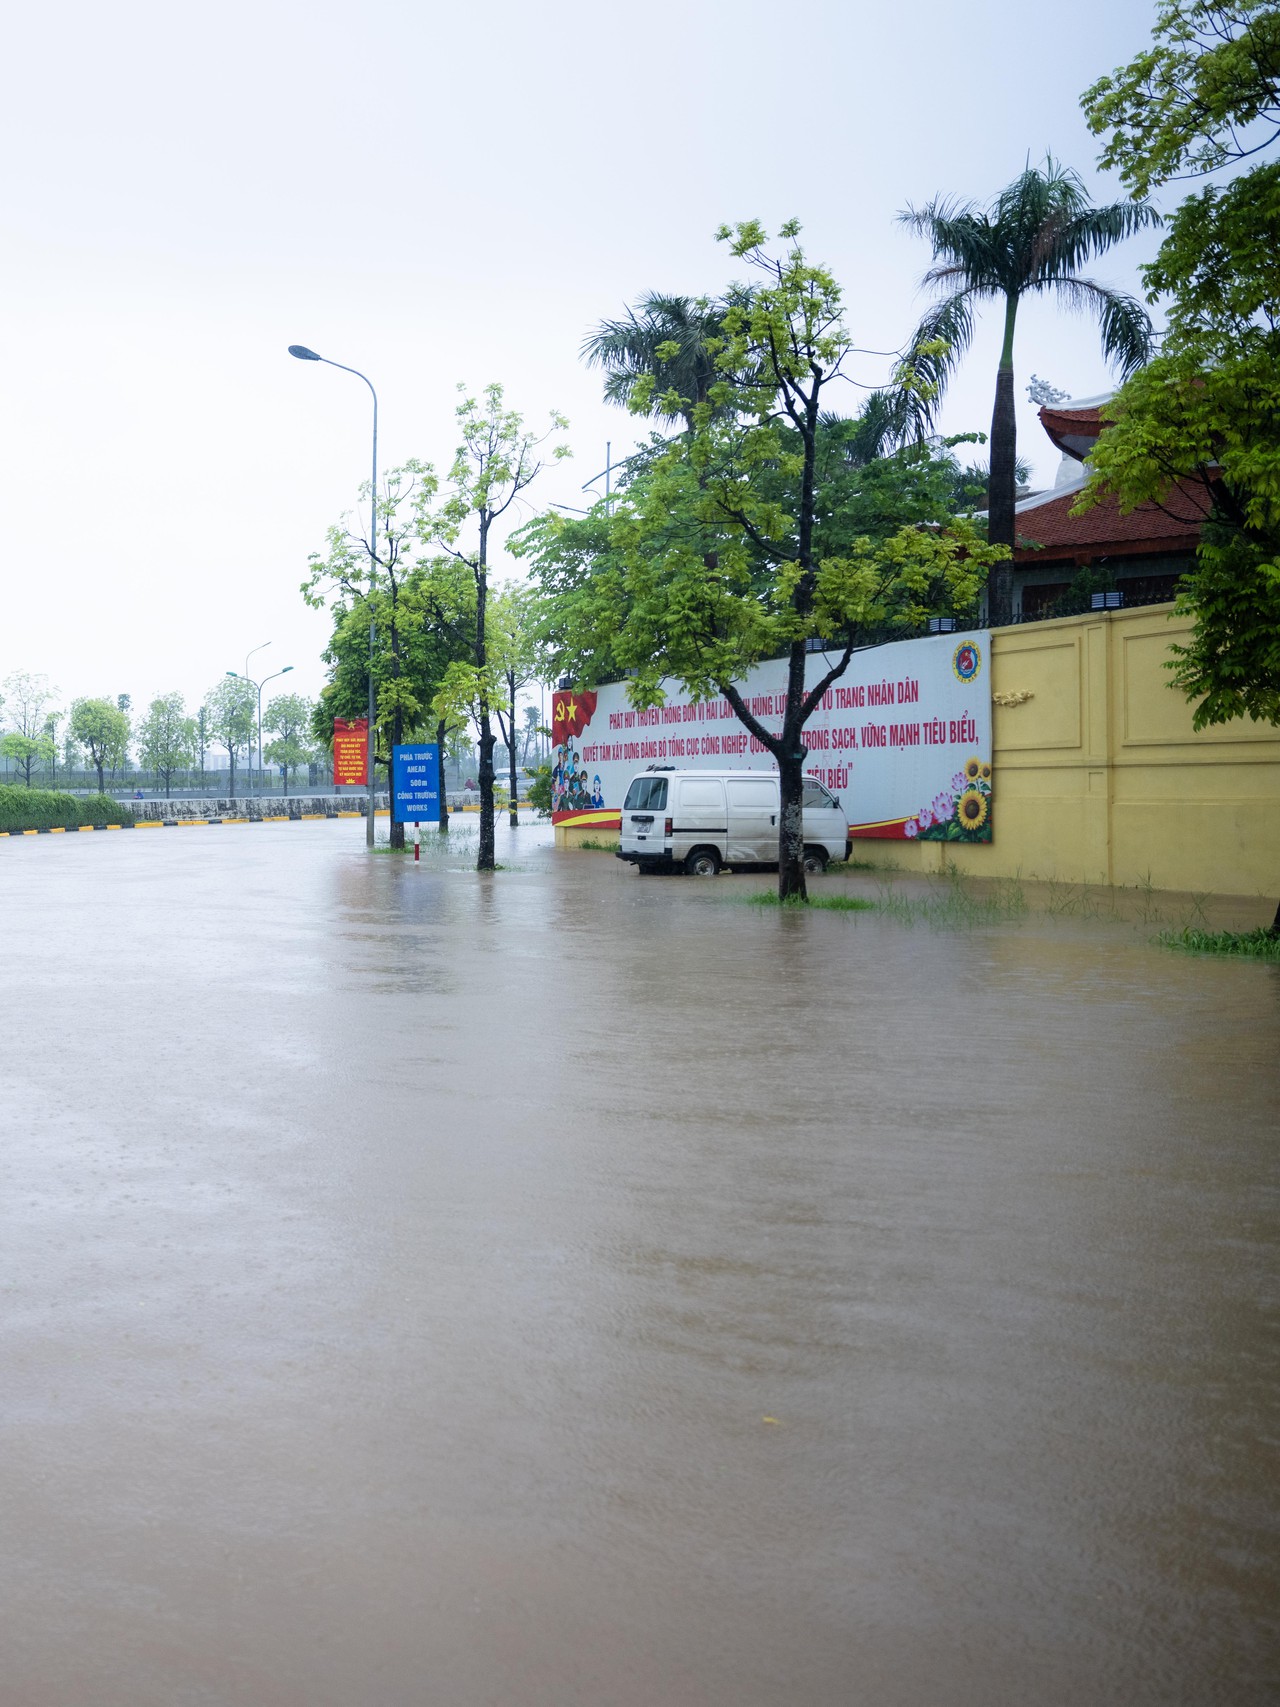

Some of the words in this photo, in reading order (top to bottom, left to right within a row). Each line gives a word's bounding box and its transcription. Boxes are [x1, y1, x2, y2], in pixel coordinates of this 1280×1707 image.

[610, 710, 623, 729] PHÁT
[625, 711, 636, 728] HUY
[706, 701, 718, 720] HAI
[752, 693, 773, 716] HÙNG
[775, 693, 788, 718] LỰ
[835, 685, 865, 709] TRANG
[868, 679, 895, 707] NHÂN
[897, 676, 918, 704] DÂN
[583, 741, 598, 764] QUYẾT
[600, 742, 610, 761] TÂM
[612, 741, 623, 760] XÂY
[624, 742, 639, 763] DỰNG
[641, 736, 657, 758] ĐẢNG
[658, 737, 667, 761] BỘ
[668, 732, 684, 756] TỔNG
[686, 738, 700, 759] CỤC
[701, 733, 720, 755] CÔNG
[722, 731, 747, 757] NGHIỆP
[801, 730, 829, 752] TRONG
[832, 727, 858, 754] SẠCH,
[861, 722, 886, 747] VỮNG
[889, 723, 919, 751] MẠNH
[923, 717, 946, 745] TIÊU
[950, 710, 979, 745] BIỂU,
[400, 752, 413, 760] PHÍA
[397, 791, 413, 800] CÔNG
